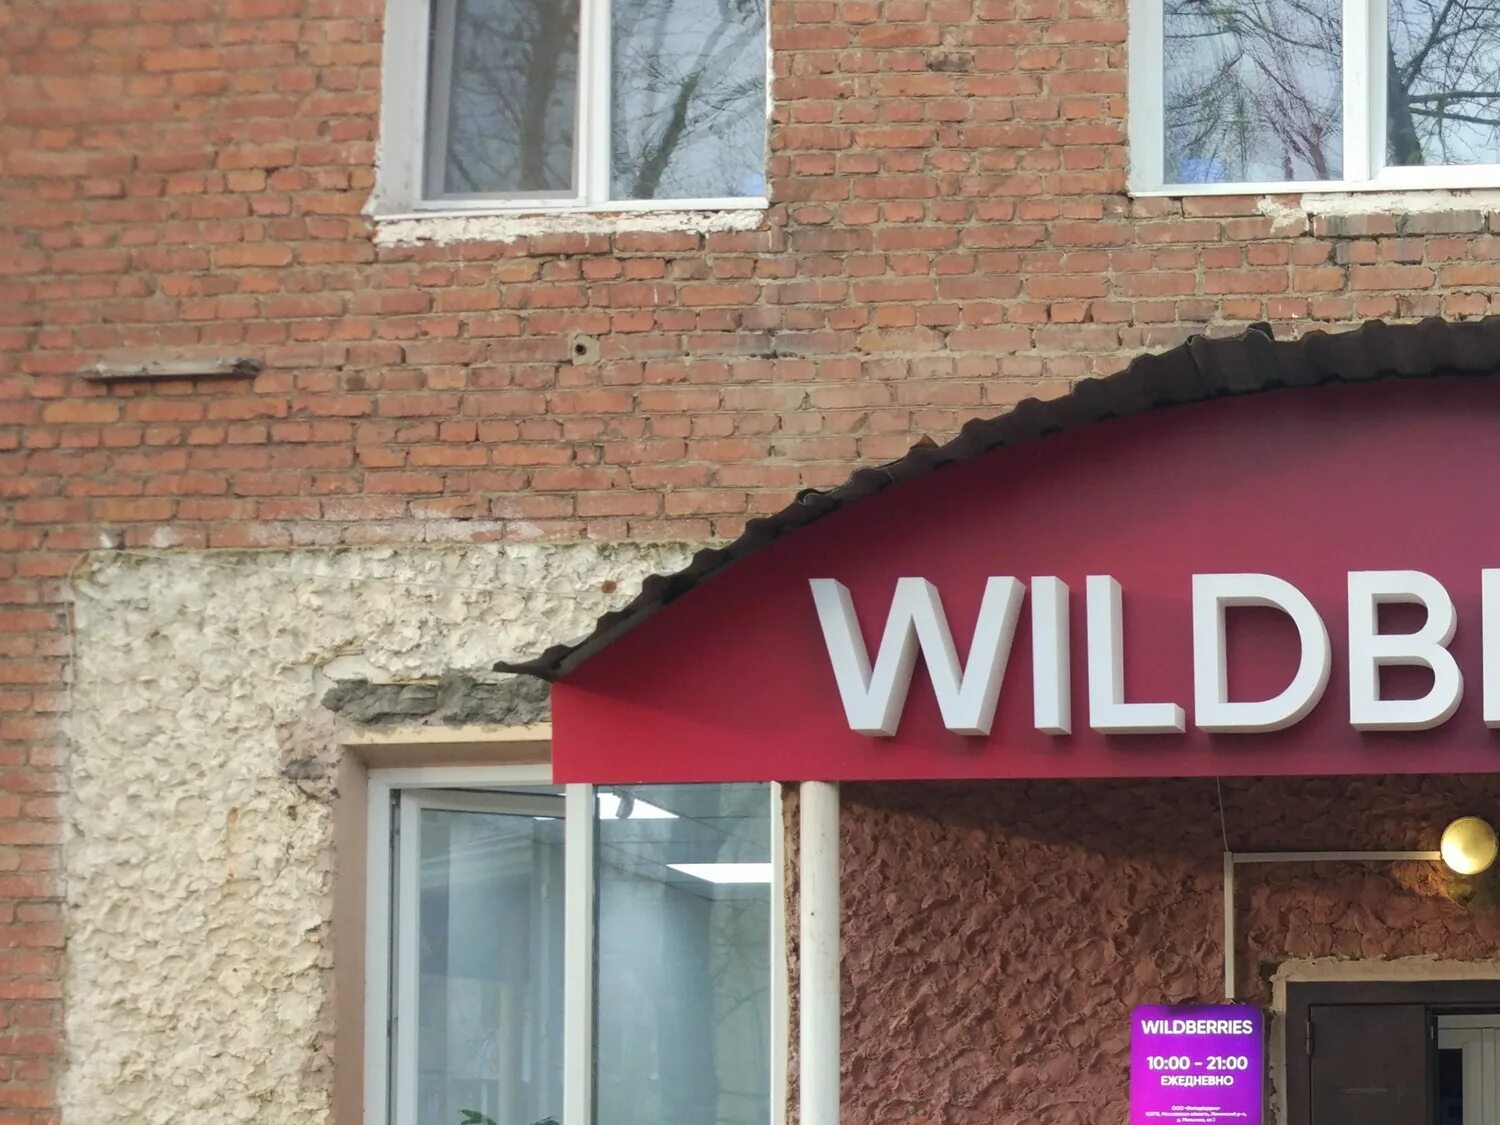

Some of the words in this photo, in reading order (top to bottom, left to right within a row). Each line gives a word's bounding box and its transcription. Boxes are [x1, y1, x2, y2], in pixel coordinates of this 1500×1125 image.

[1141, 1019, 1253, 1035] WILDBERRIES
[1146, 1055, 1190, 1070] 10:00
[1206, 1055, 1248, 1070] 21:00
[1161, 1075, 1234, 1087] ЕЖЕДНЕВНО
